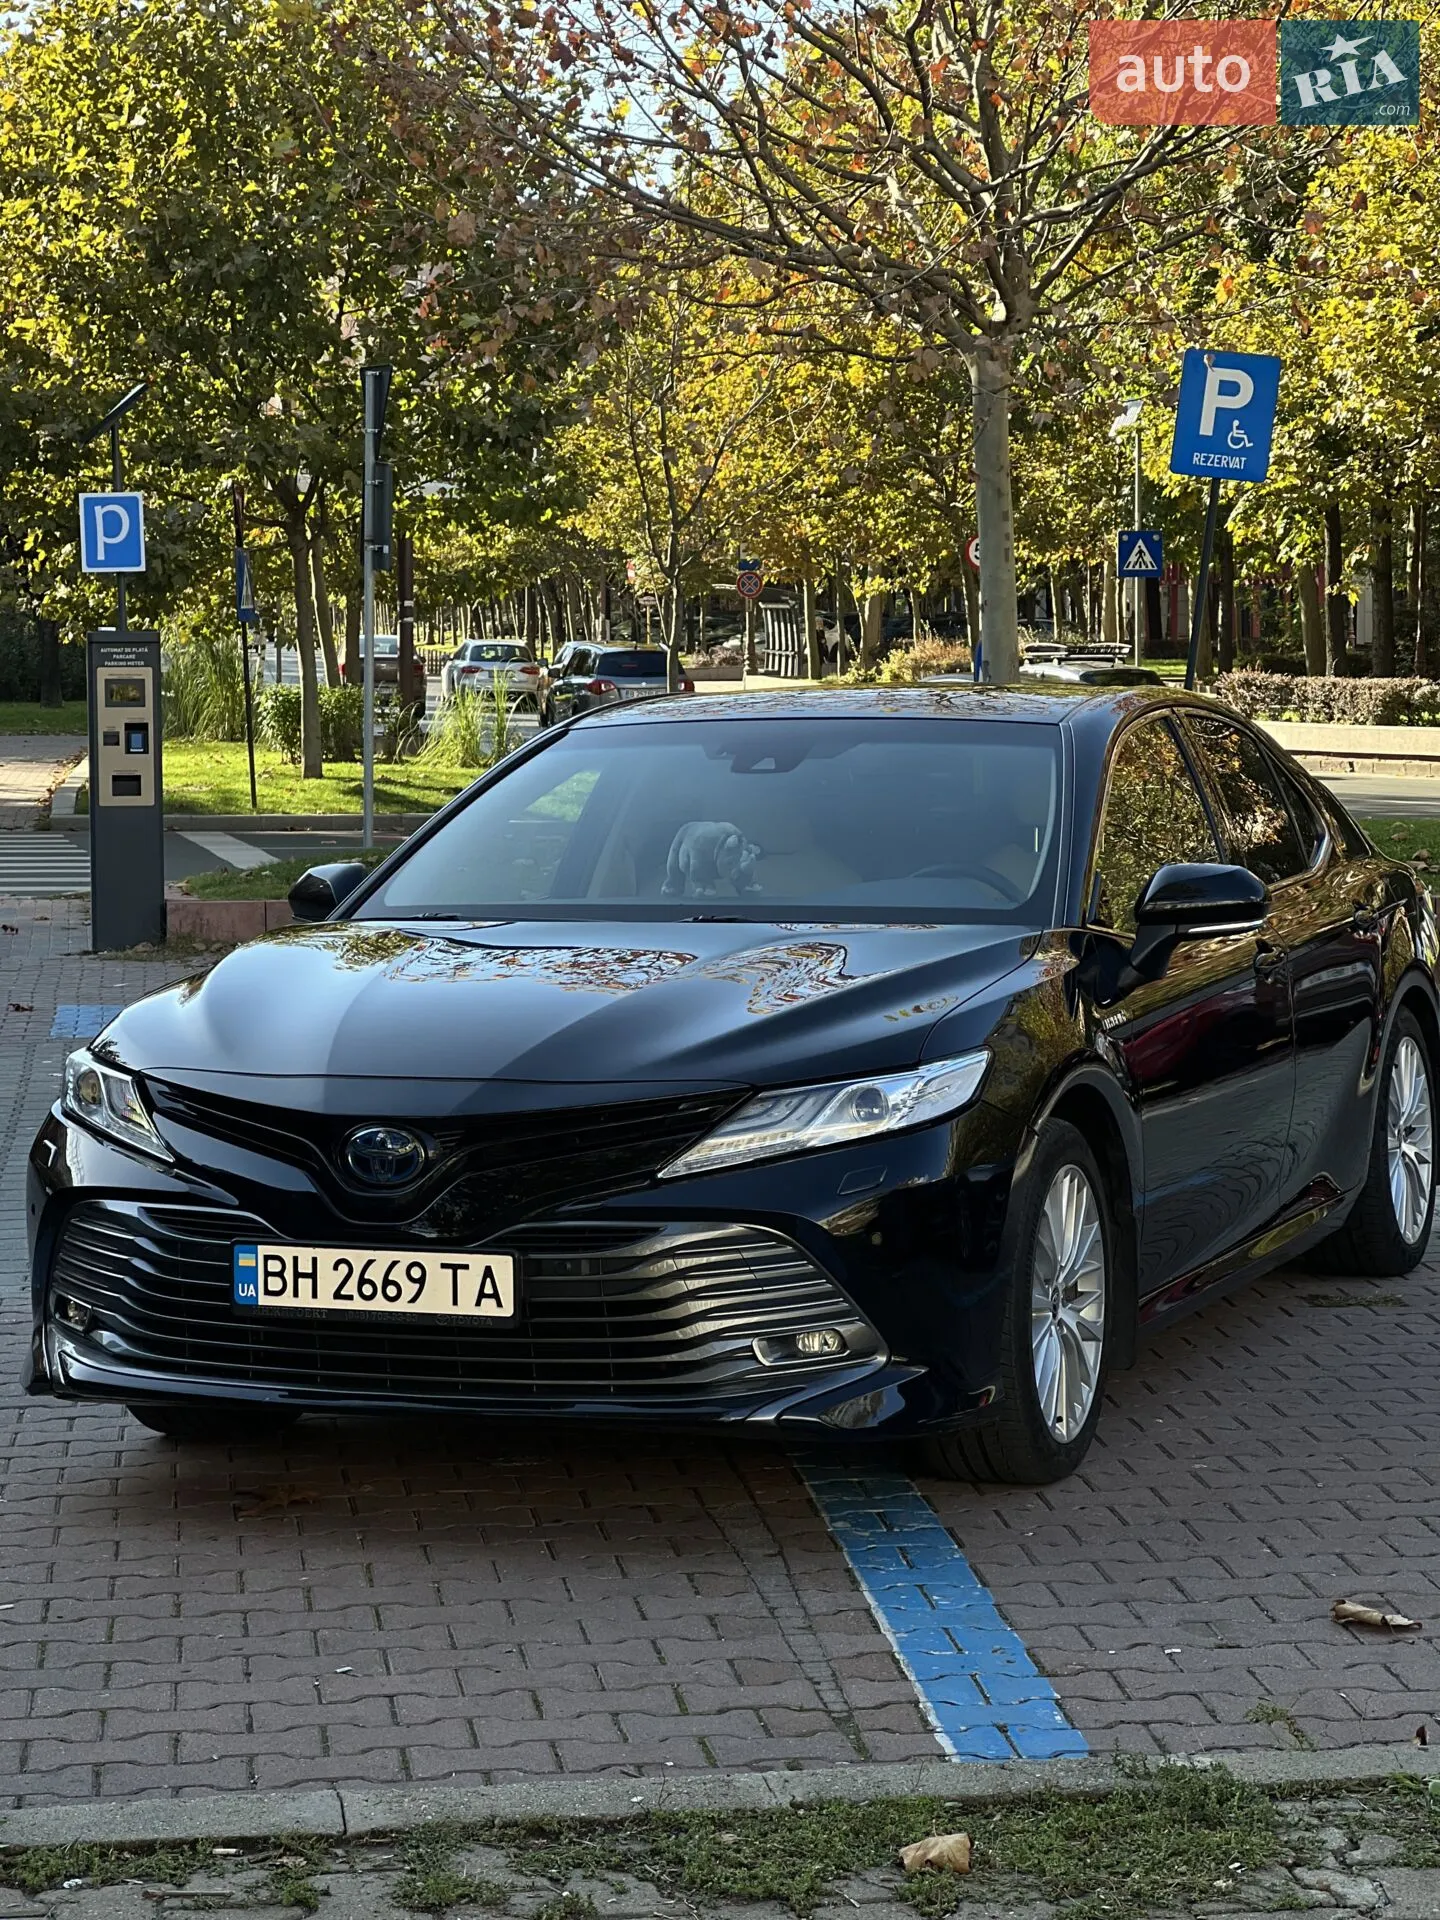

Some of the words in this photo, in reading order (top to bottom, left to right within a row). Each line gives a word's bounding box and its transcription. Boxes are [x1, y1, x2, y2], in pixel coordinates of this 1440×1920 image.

[1199, 367, 1254, 436] P
[1192, 452, 1247, 470] REZERVAT
[94, 504, 130, 560] P
[238, 1283, 256, 1297] UA
[263, 1254, 318, 1299] BH
[332, 1258, 427, 1304] 2669
[440, 1262, 505, 1308] TA
[451, 1314, 493, 1326] TOYOTA
